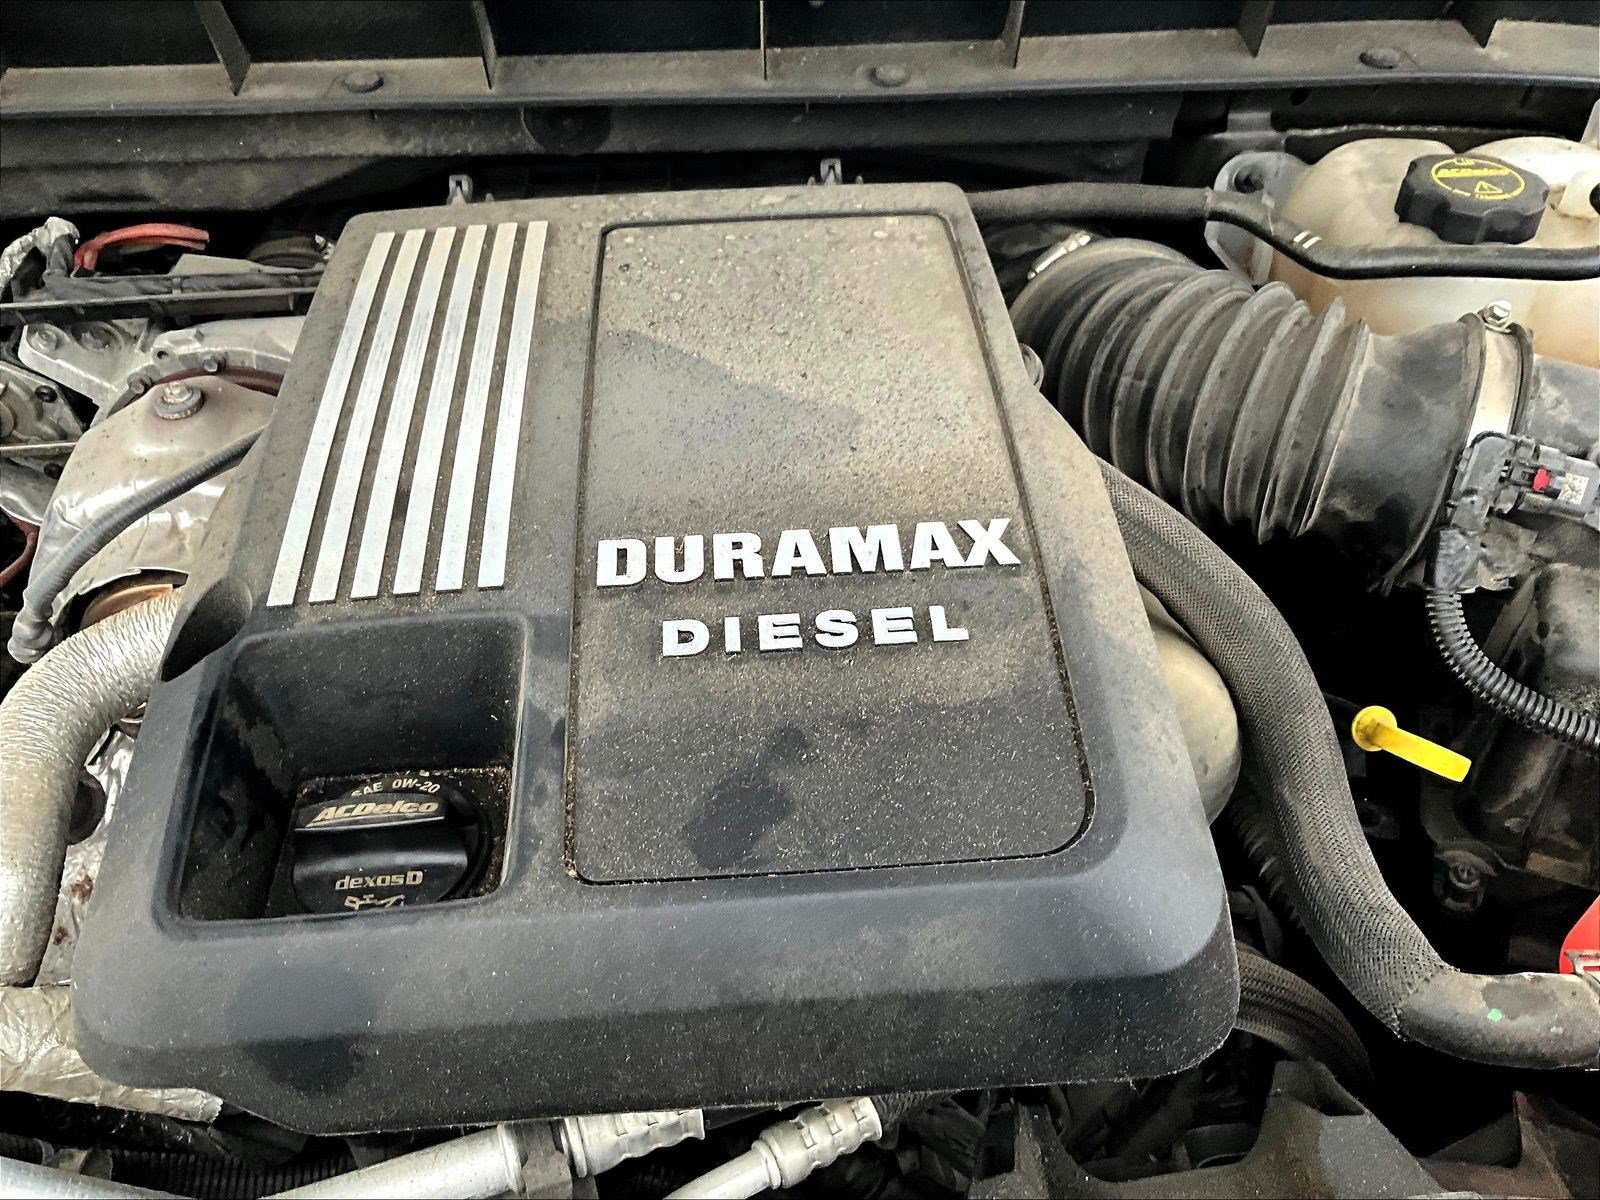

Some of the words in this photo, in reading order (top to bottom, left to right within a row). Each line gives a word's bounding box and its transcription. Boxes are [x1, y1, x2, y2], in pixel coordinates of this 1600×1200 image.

[596, 517, 1021, 587] DURAMAX
[662, 605, 969, 658] DIESEL
[392, 778, 441, 794] 0W-20
[311, 800, 439, 822] ACDelco
[335, 870, 424, 890] dexosD
